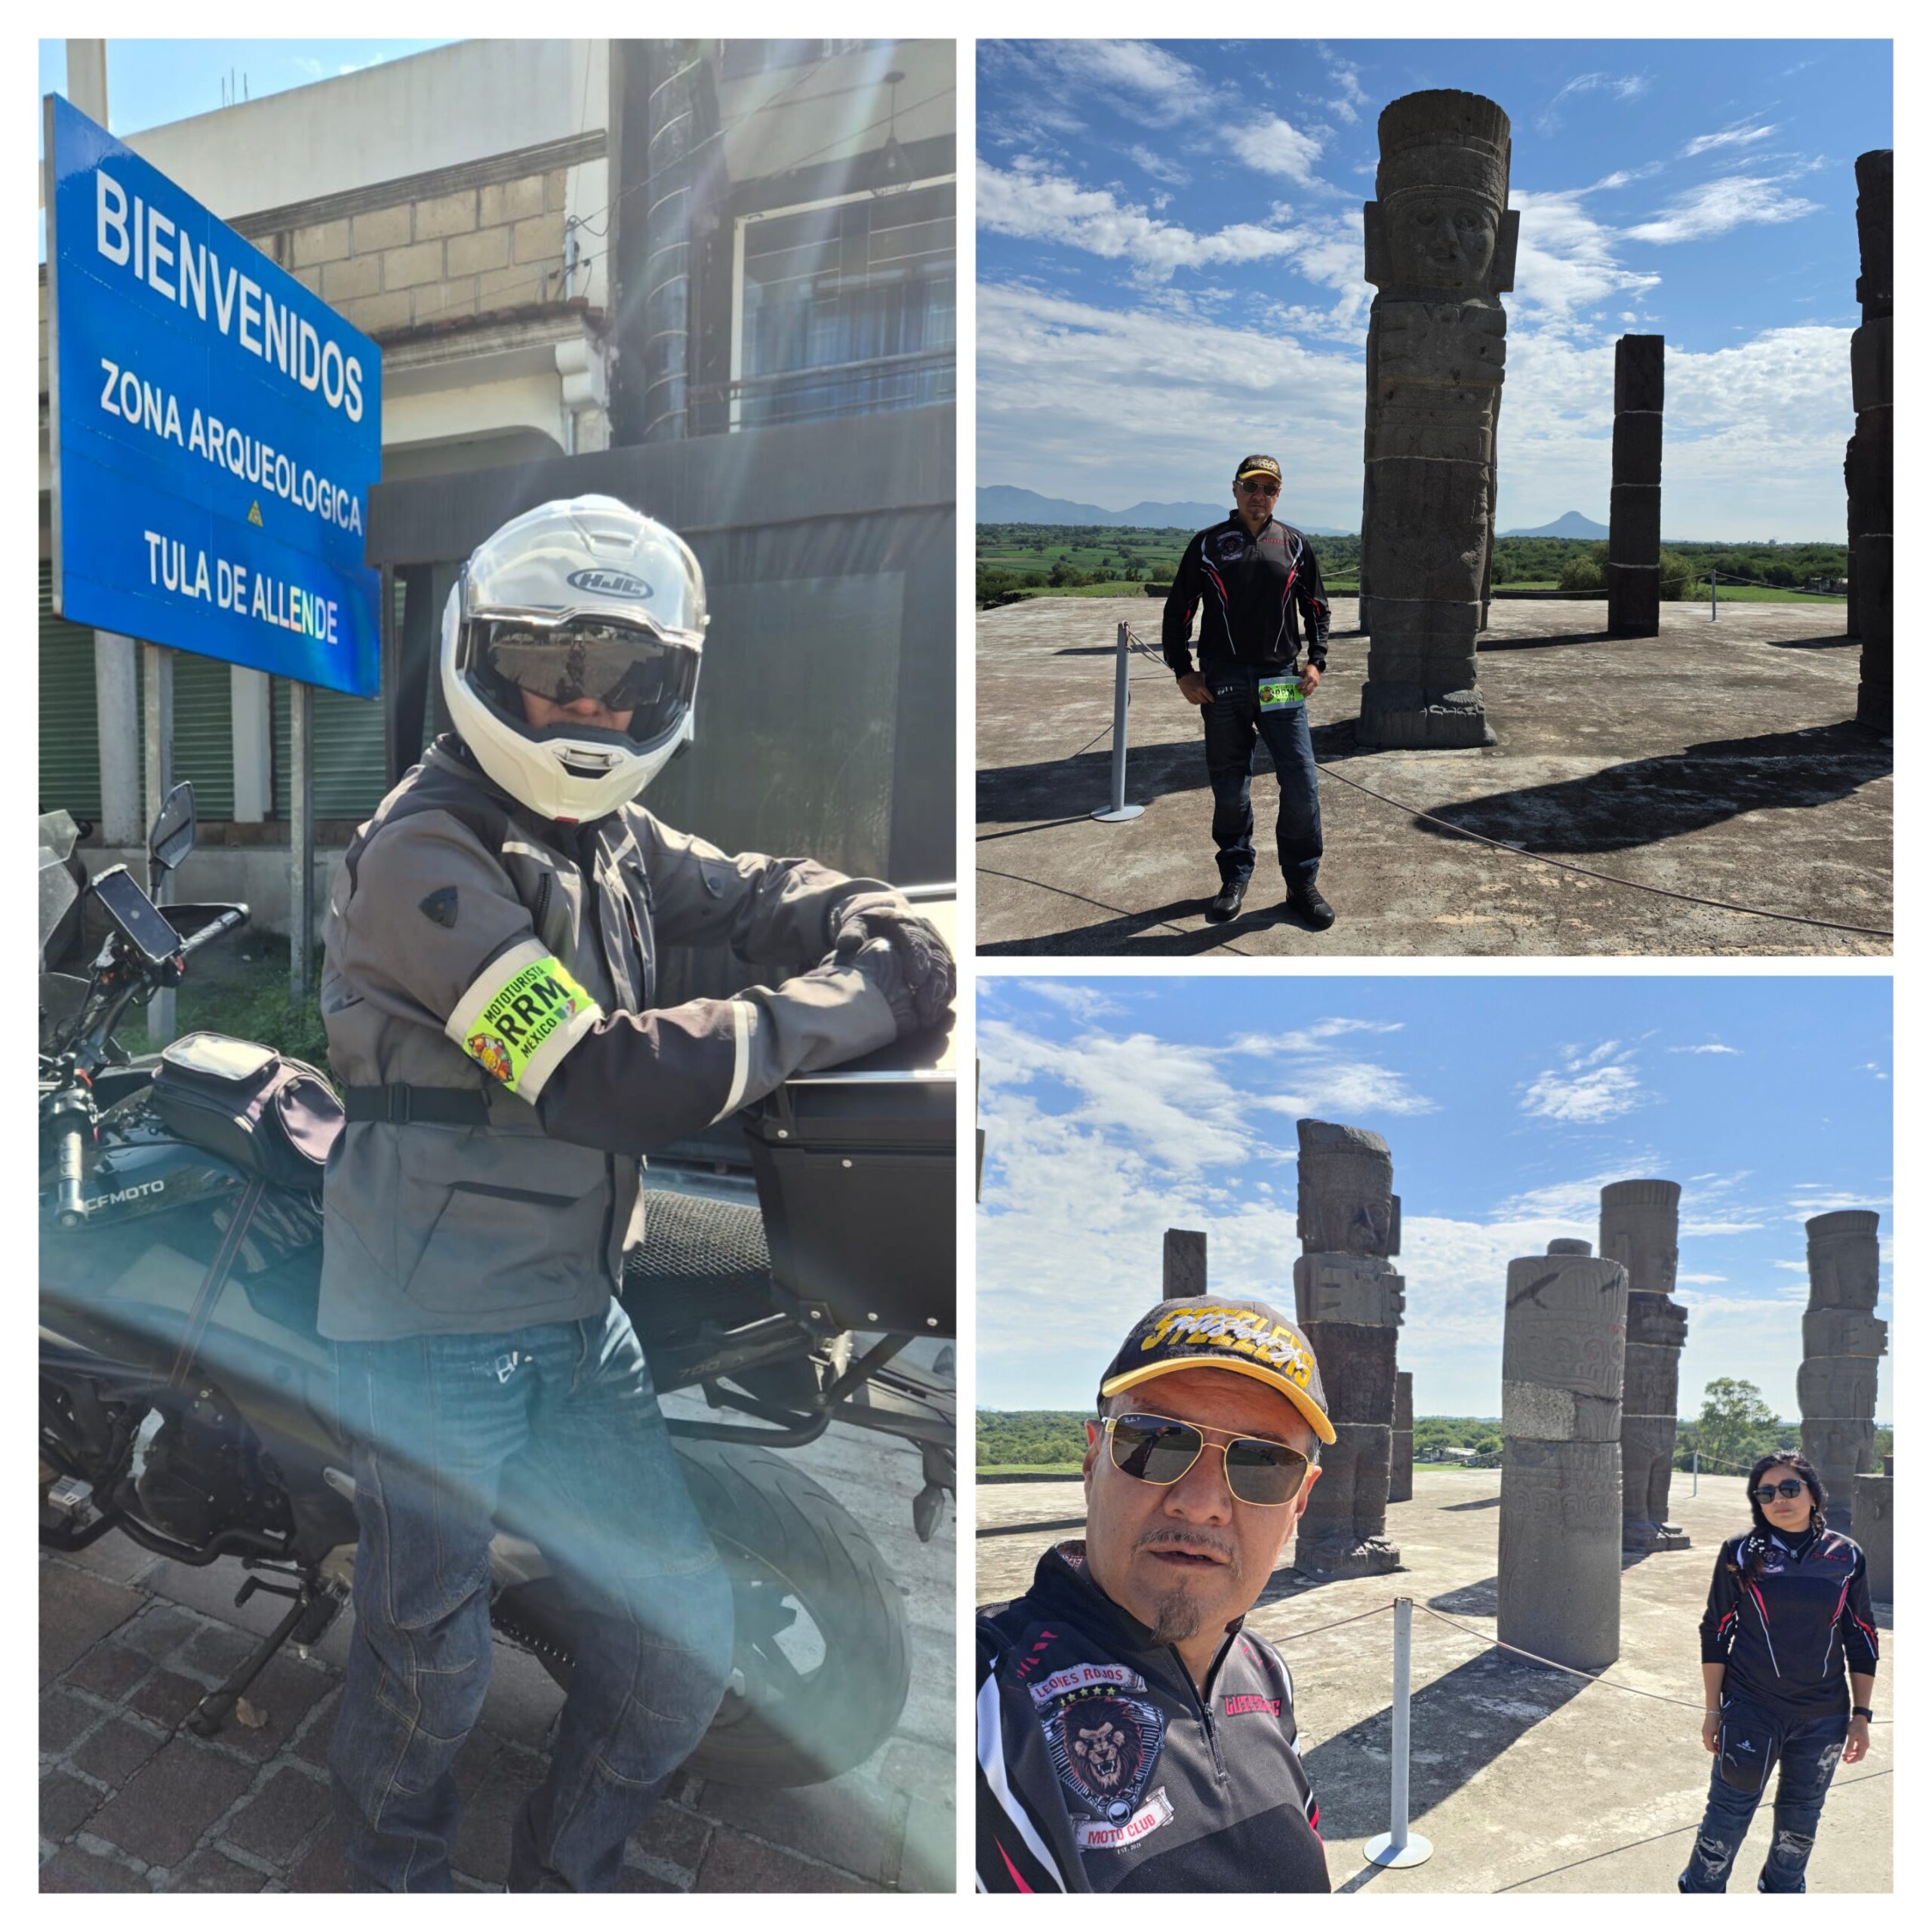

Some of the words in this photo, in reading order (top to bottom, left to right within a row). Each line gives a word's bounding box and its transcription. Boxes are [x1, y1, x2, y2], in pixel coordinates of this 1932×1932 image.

[96, 168, 363, 423] BIENVENIDOS
[100, 358, 183, 447] ZONA
[189, 408, 362, 537] ARQUEOLOGICA
[144, 530, 211, 602] TULA
[217, 558, 247, 614] DE
[252, 573, 338, 645] ALLENDE
[579, 574, 641, 594] HJC
[484, 965, 546, 1024] MOTOTURISTA
[494, 975, 571, 1047] RRM
[85, 1180, 165, 1211] CFMOTO
[1035, 1672, 1079, 1698] LEONES
[1083, 1668, 1124, 1681] ROJOS
[1088, 1828, 1124, 1844] MOTO
[1127, 1814, 1156, 1836] CLUB
